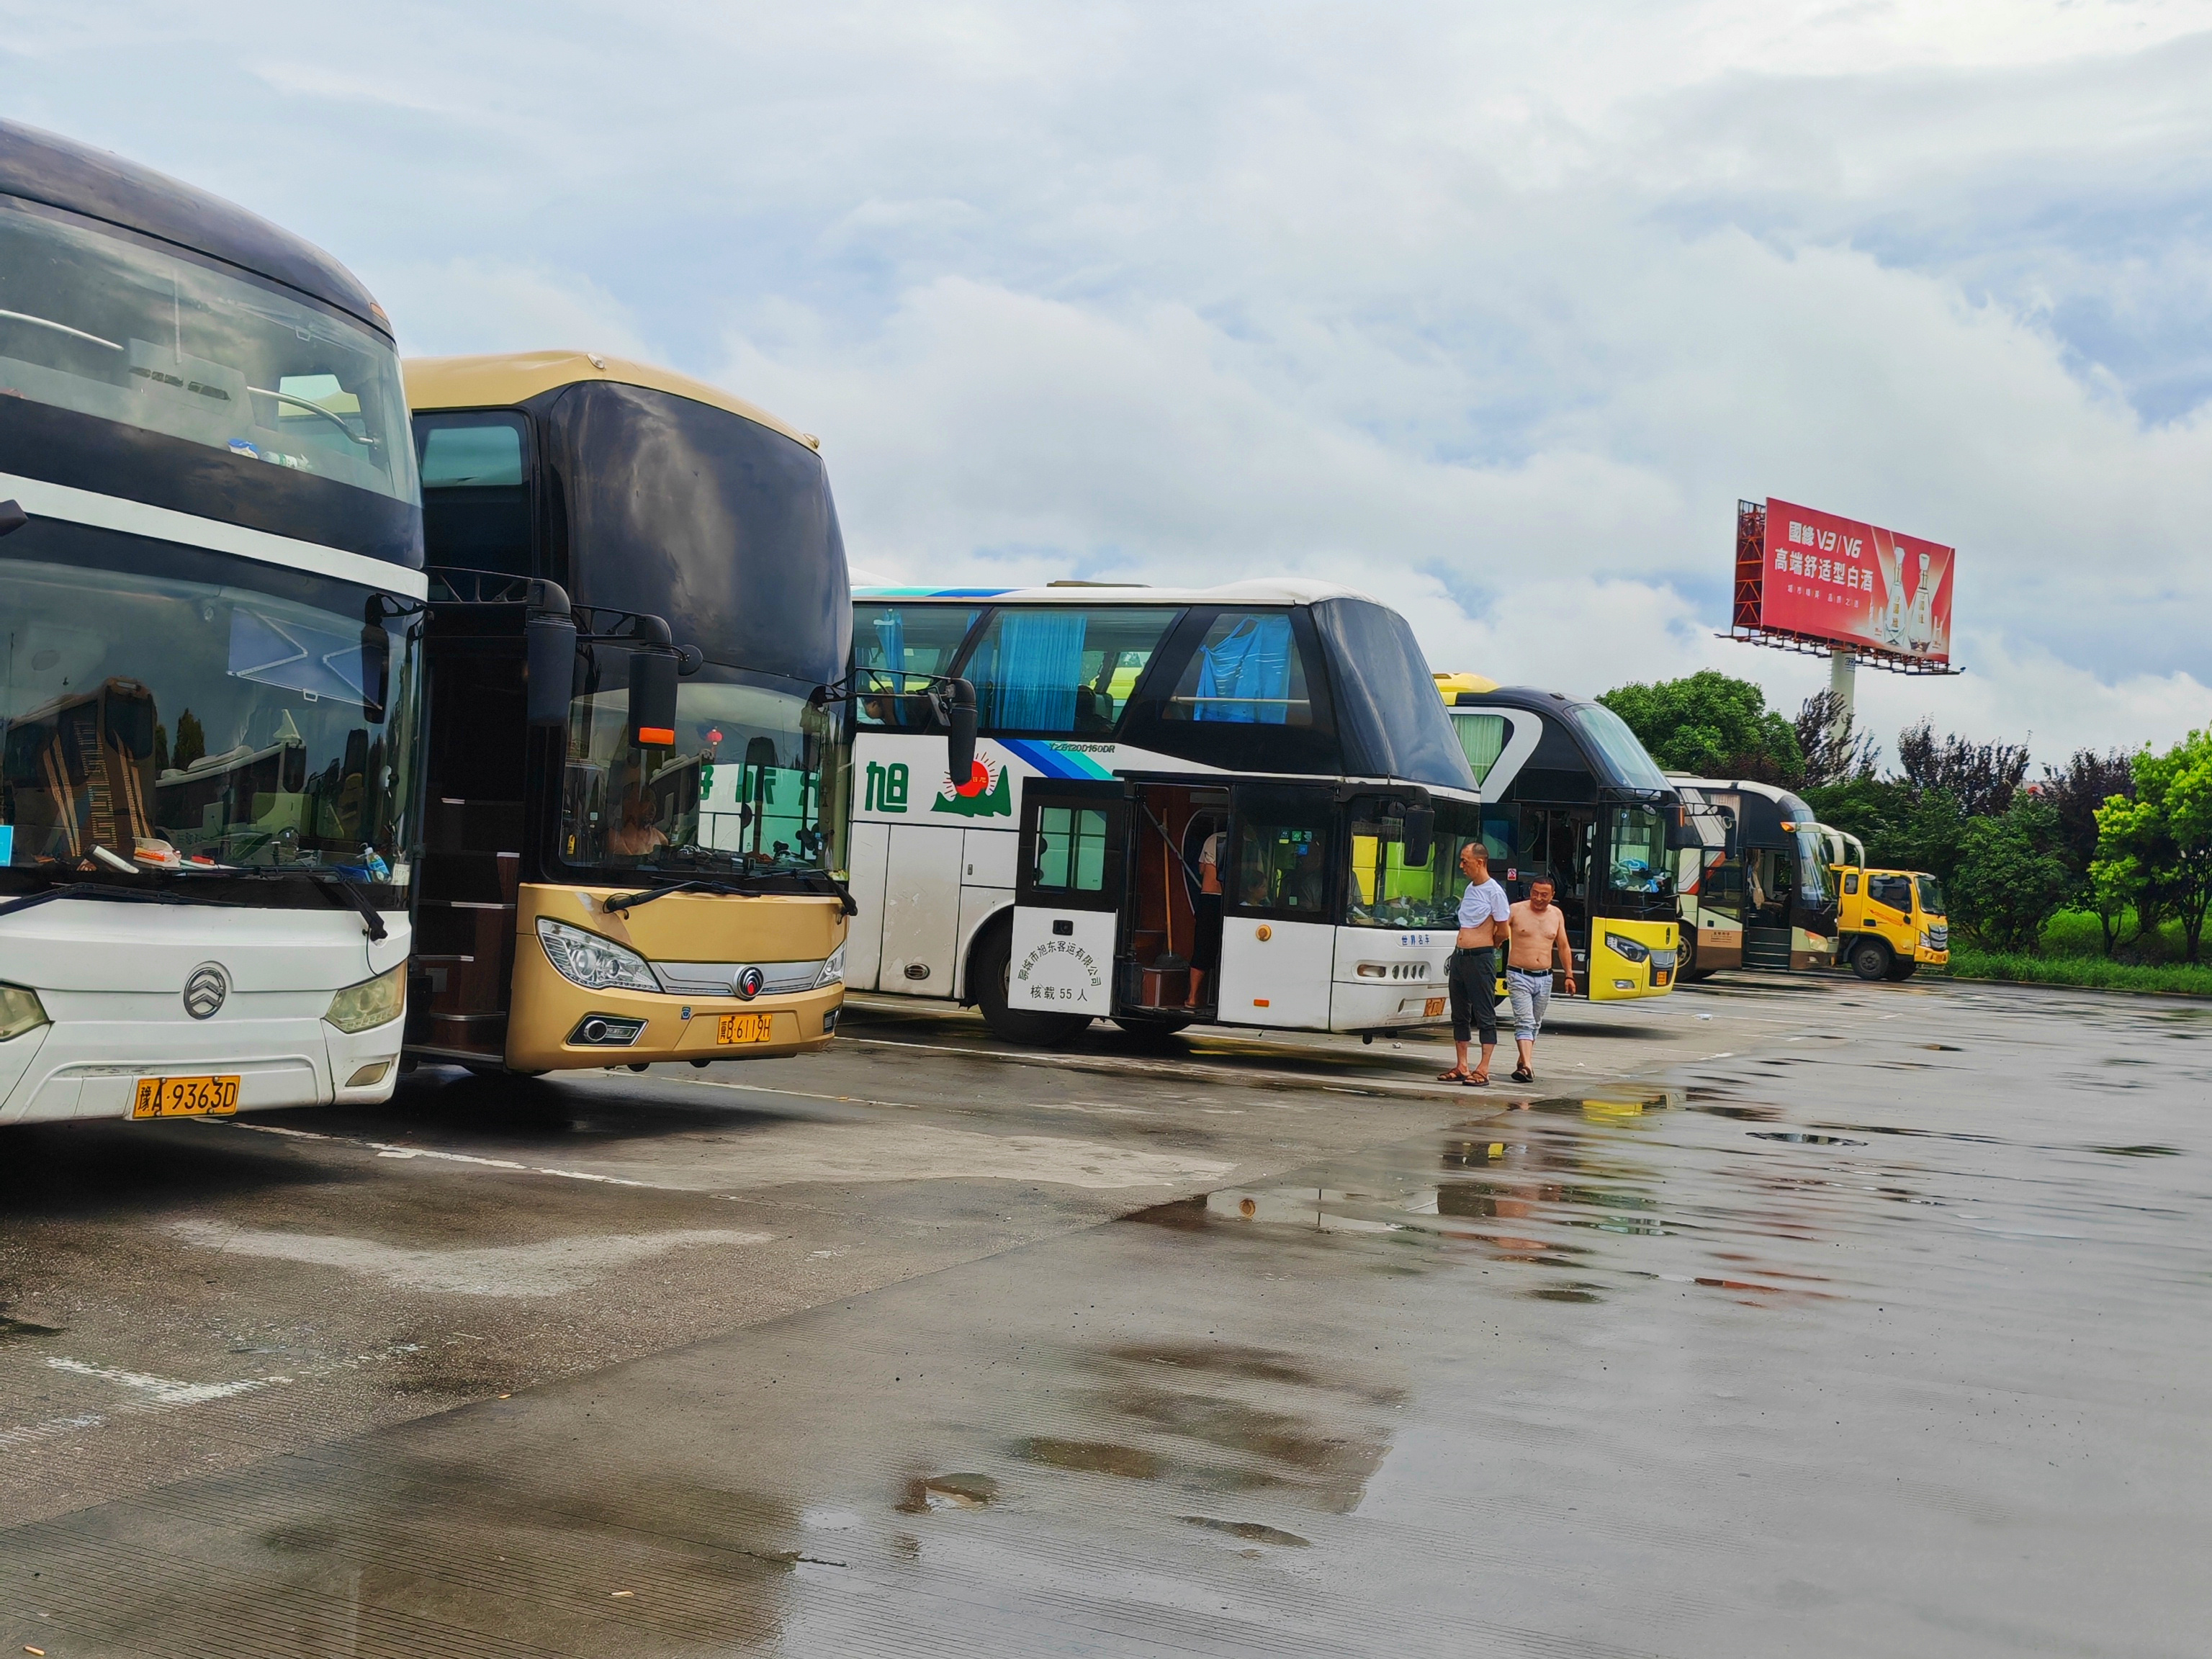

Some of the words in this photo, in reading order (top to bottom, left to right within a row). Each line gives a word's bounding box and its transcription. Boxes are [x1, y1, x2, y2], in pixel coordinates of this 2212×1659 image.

[1817, 529, 1863, 558] V3/V6
[1775, 547, 1874, 593] 高端舒适型白酒
[865, 761, 909, 813] 旭
[1401, 934, 1430, 945] 世界名车
[1030, 985, 1055, 1000] 核载
[1060, 988, 1072, 999] 55
[1076, 988, 1088, 1002] 人
